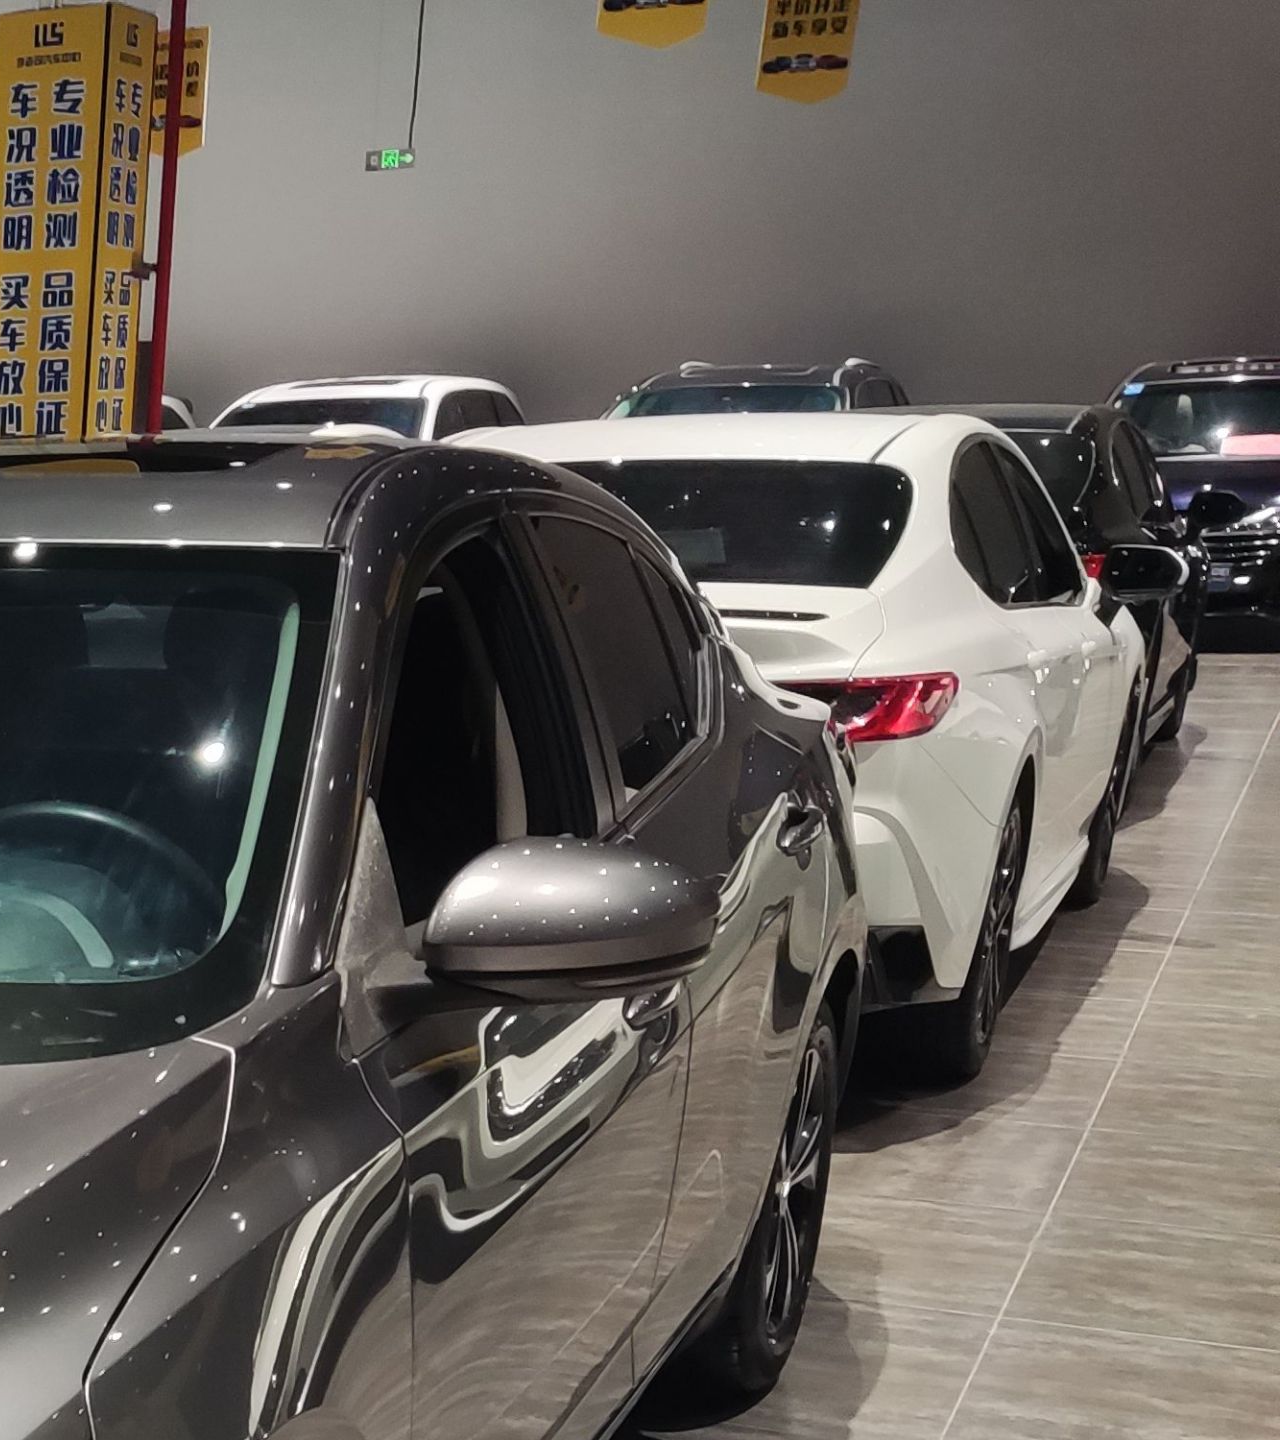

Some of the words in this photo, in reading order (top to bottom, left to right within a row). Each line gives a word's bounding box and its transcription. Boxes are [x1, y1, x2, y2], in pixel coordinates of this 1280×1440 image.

[3, 83, 38, 250] 车况透明
[44, 78, 85, 248] 专业检测
[106, 78, 127, 246] 车况透明
[122, 82, 143, 248] 专业检测
[35, 271, 74, 437] 品质保证
[95, 270, 116, 432] 买车放心
[111, 271, 132, 431] 品质保证
